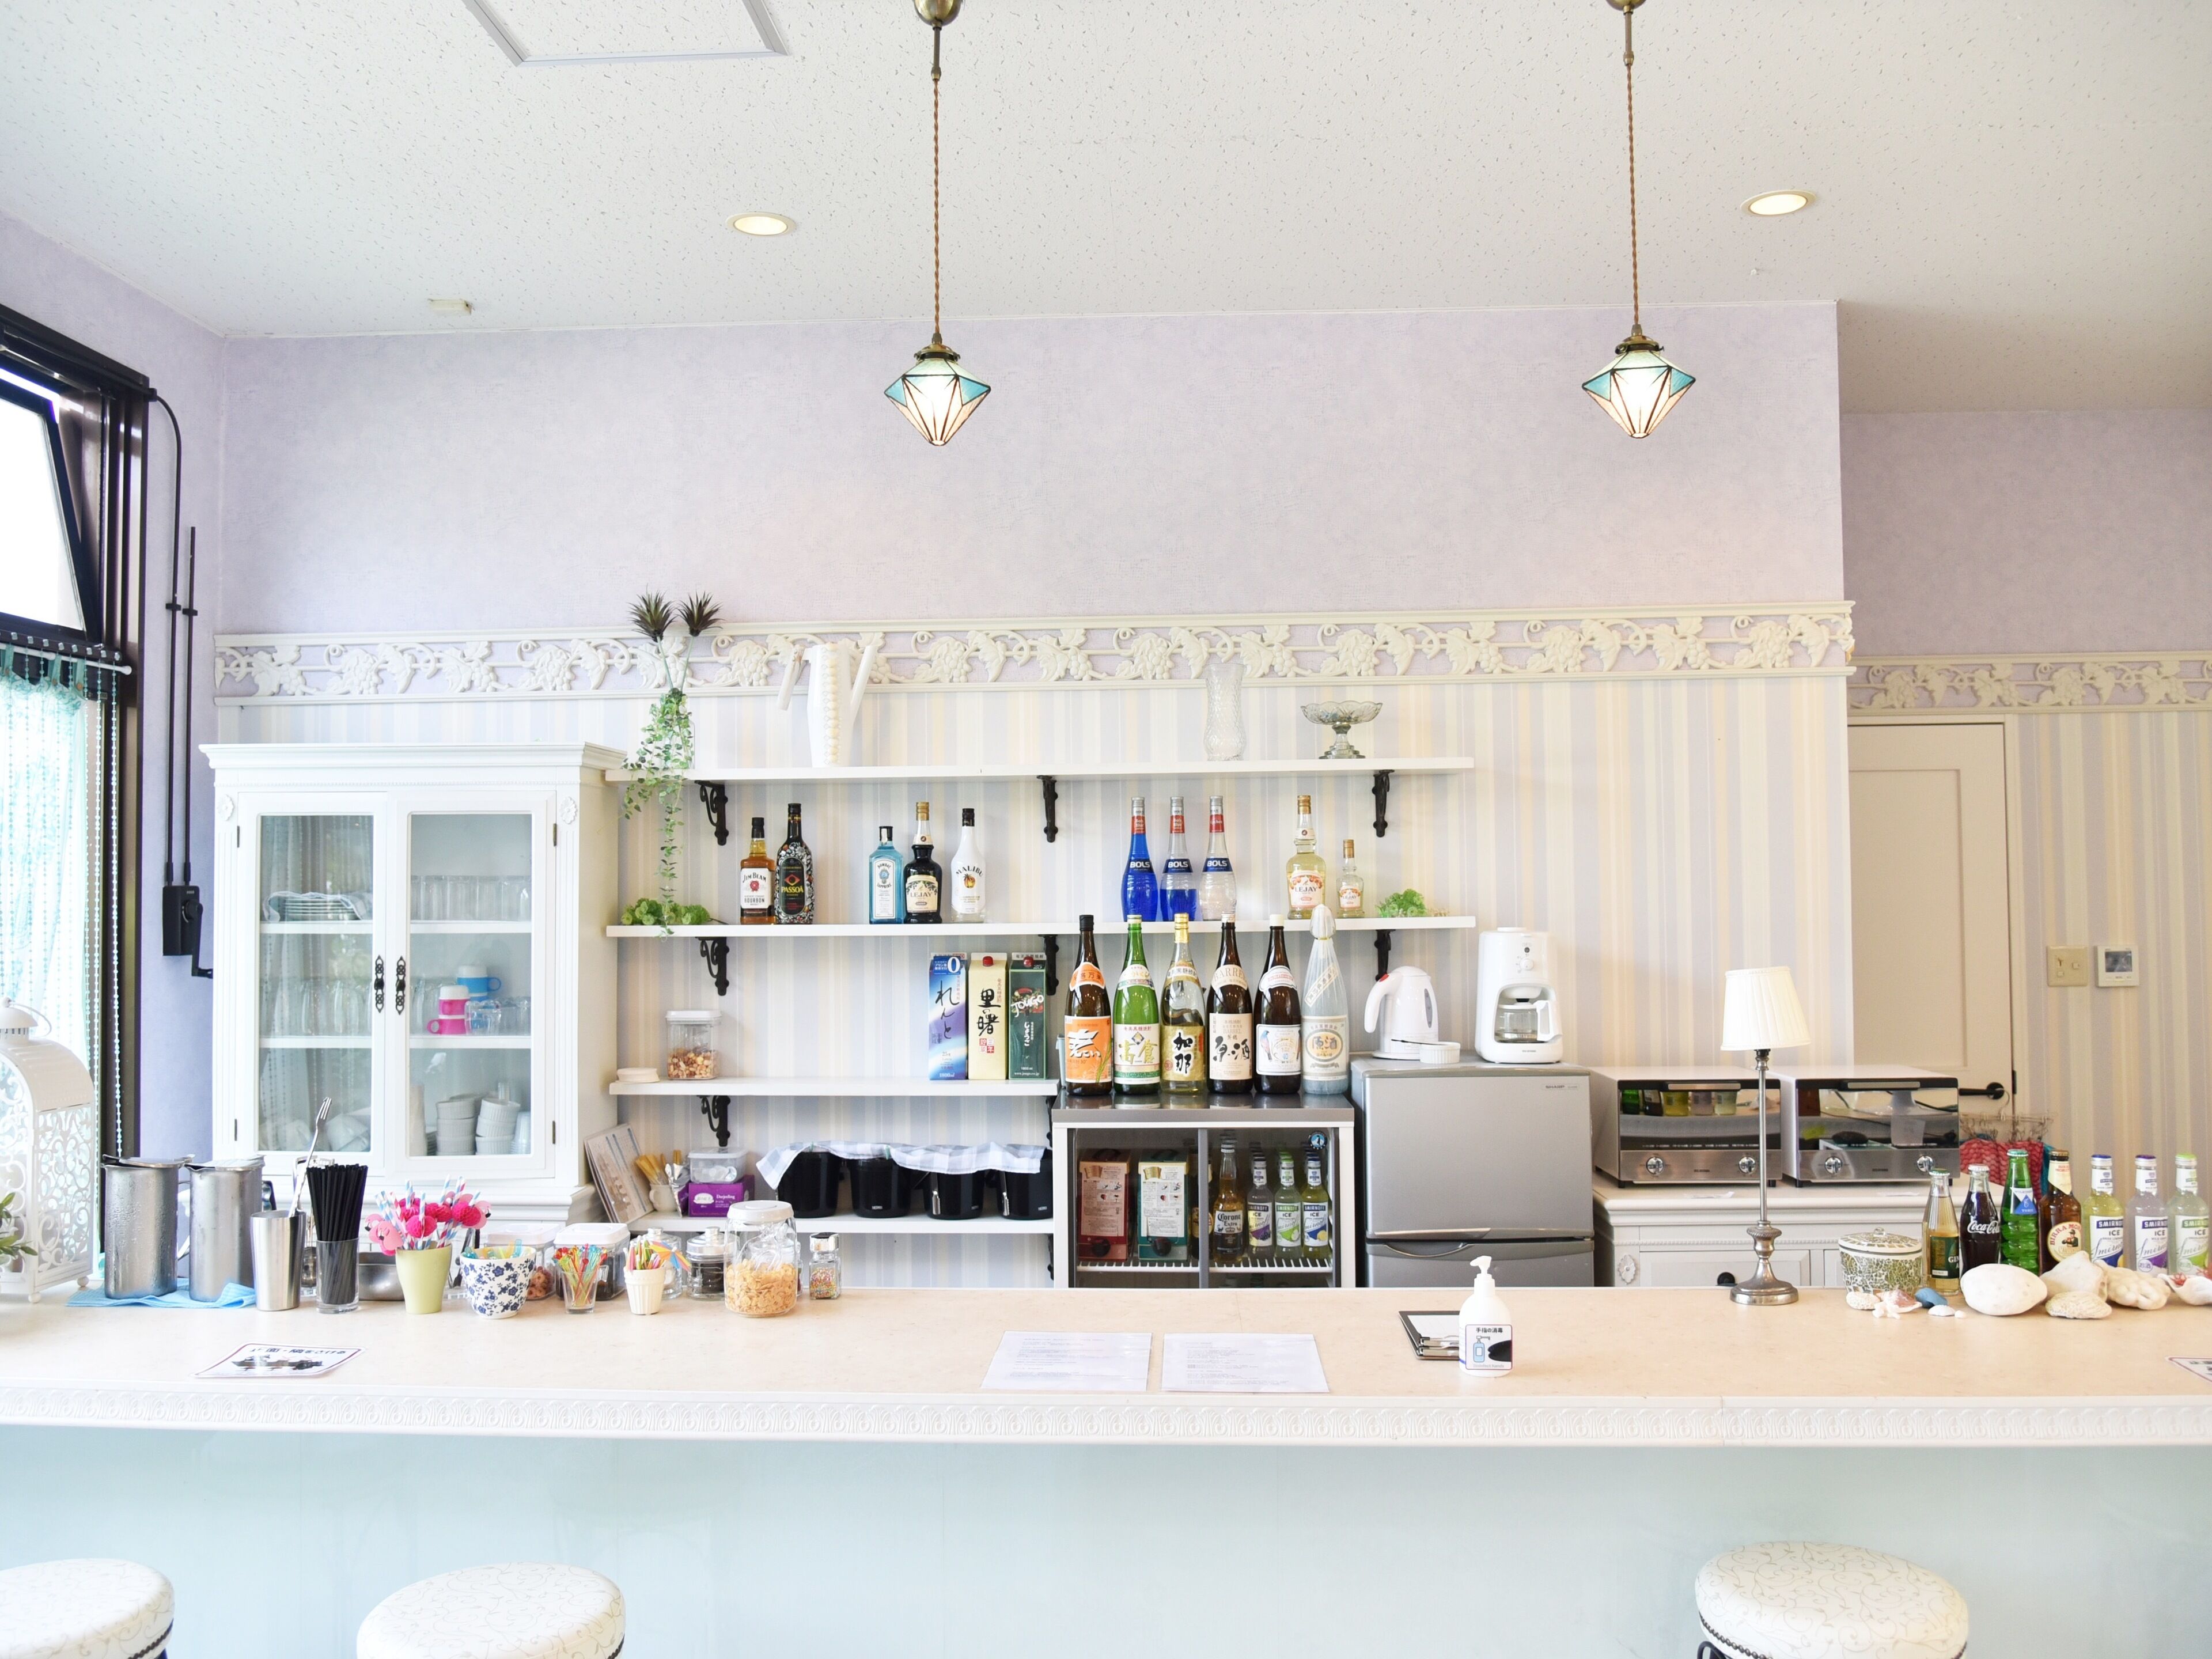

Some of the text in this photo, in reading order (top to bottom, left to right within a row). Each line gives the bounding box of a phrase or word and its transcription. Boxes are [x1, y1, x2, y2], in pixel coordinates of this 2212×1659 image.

[743, 872, 767, 883] JIM BEAM
[956, 865, 983, 877] MALIBU
[947, 956, 960, 973] 0
[935, 980, 960, 1039] れんと
[977, 988, 1001, 1037] 里の曙
[1010, 994, 1044, 1018] JOUGO
[1173, 1032, 1194, 1074] 加那
[1217, 1213, 1241, 1222] Corona
[2050, 1225, 2067, 1245] BIRRA
